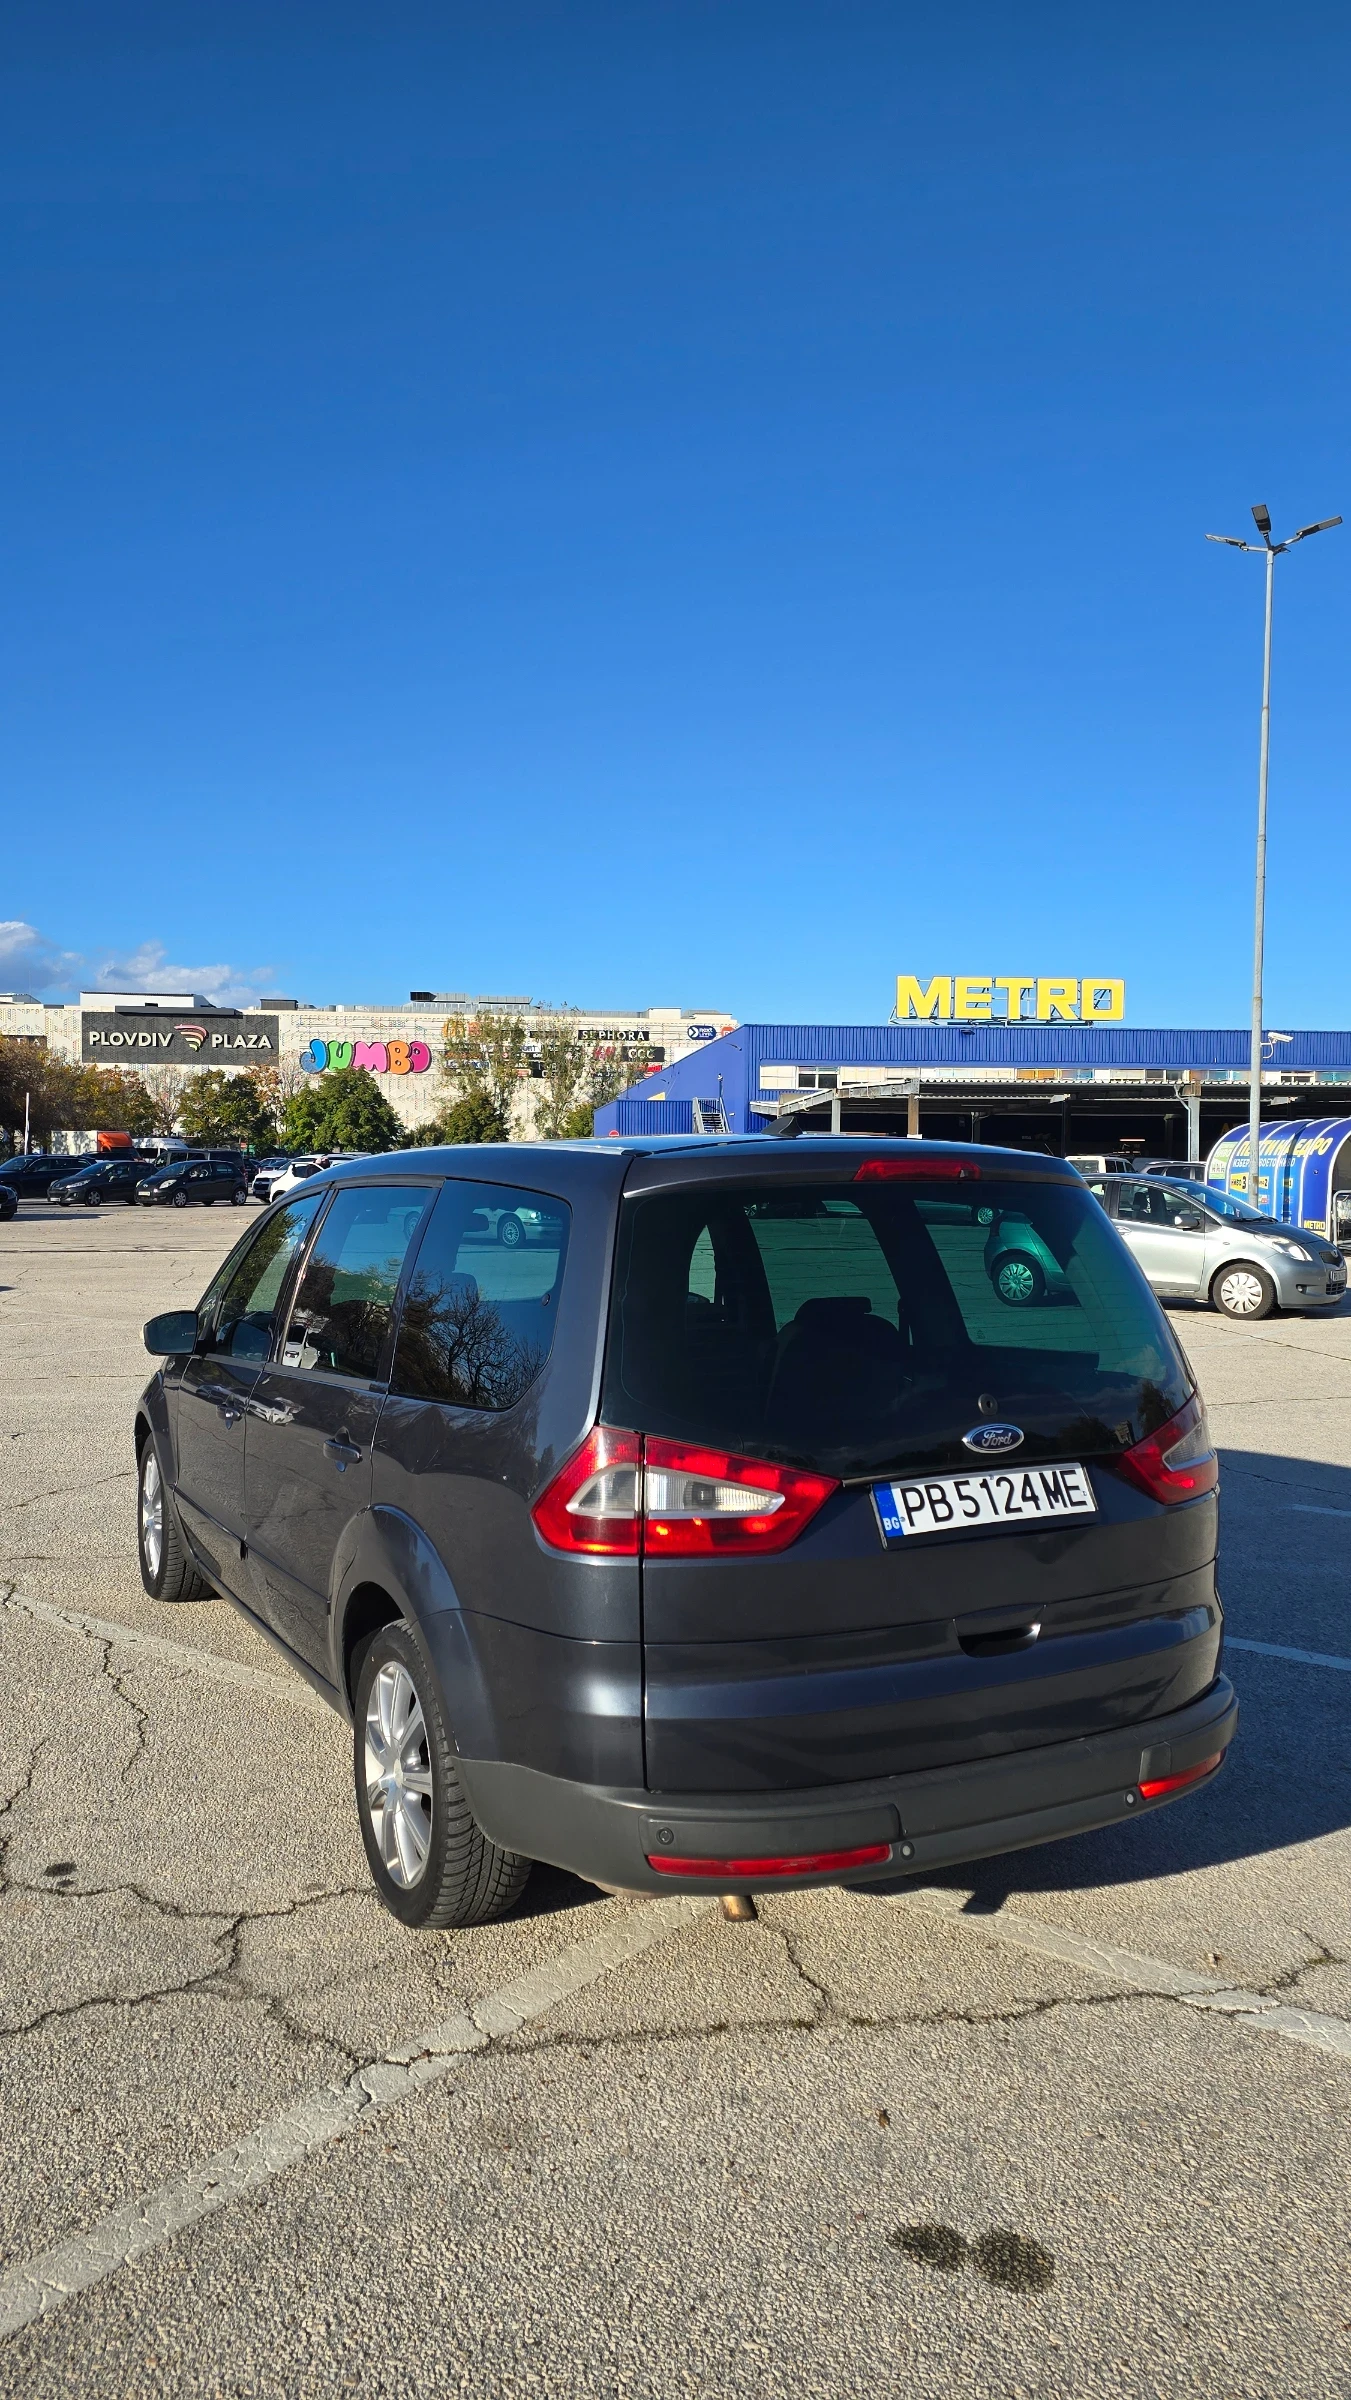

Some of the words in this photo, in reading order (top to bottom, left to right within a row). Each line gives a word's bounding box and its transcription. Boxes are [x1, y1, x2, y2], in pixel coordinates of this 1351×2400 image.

[896, 975, 1125, 1021] METRO
[89, 1031, 173, 1047] PLOVDIV
[212, 1034, 272, 1049] PLAZA
[300, 1039, 432, 1075] JUMBO
[1241, 1175, 1247, 1190] 3
[1304, 1220, 1326, 1230] METRO
[982, 1430, 1012, 1447] Ford
[900, 1469, 1088, 1527] PB5124ME
[883, 1517, 900, 1531] BG
